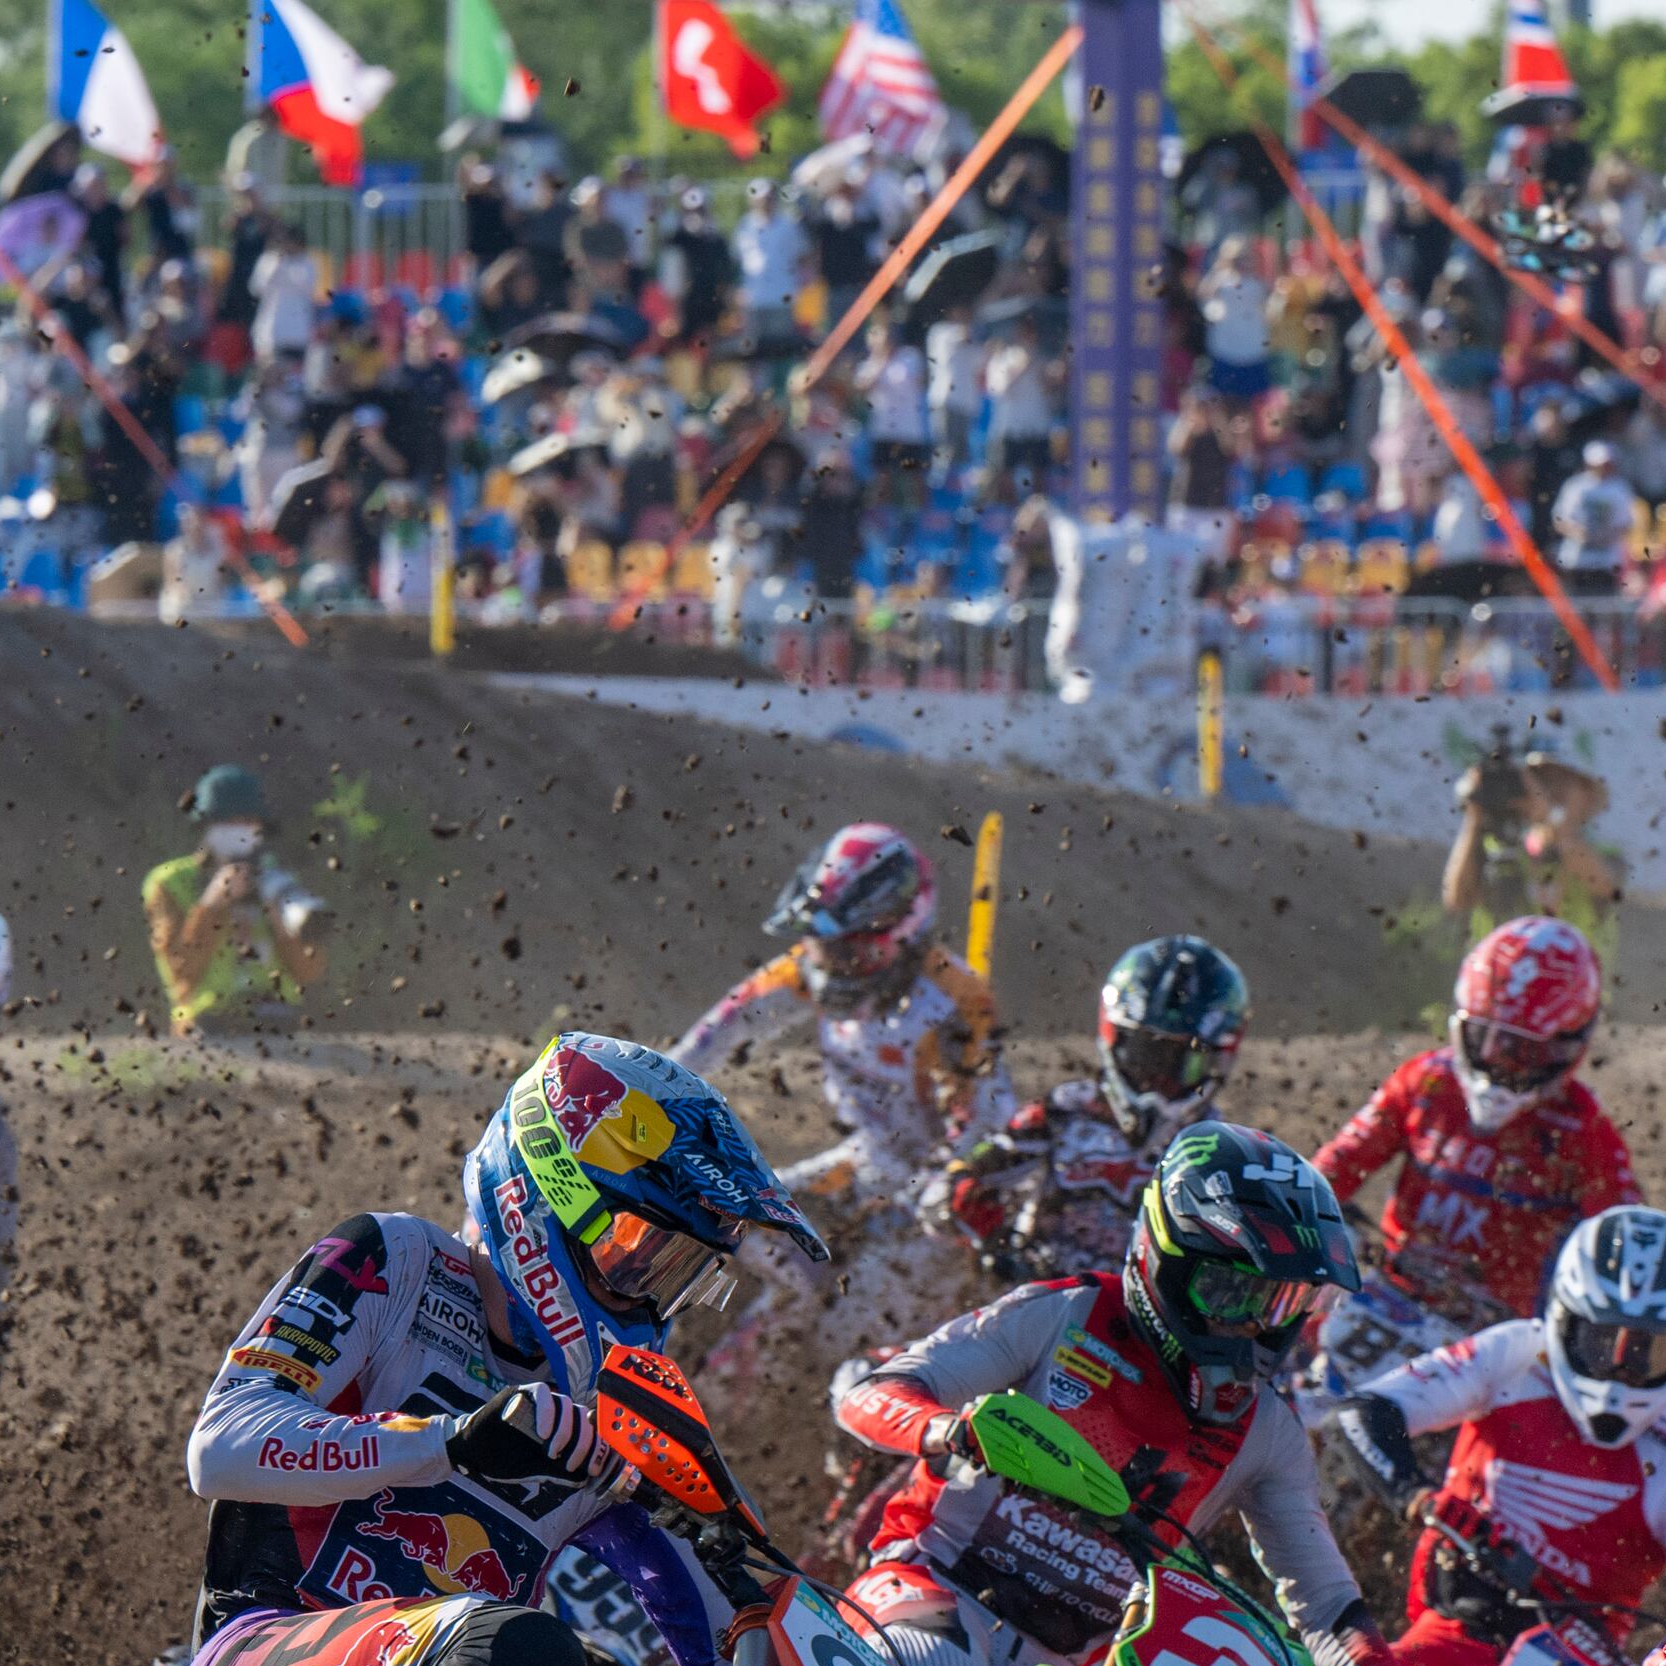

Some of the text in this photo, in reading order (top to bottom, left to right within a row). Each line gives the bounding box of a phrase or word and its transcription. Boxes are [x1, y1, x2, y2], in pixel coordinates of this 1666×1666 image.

[684, 1153, 749, 1205] AIROH
[493, 1173, 588, 1348] Red Bull
[420, 1292, 487, 1345] AIROH
[257, 1435, 380, 1472] Red Bull
[990, 1403, 1073, 1470] ACERBIS
[995, 1496, 1139, 1583] Kawasa
[1008, 1530, 1085, 1583] Racing
[1490, 1513, 1592, 1587] ONDA
